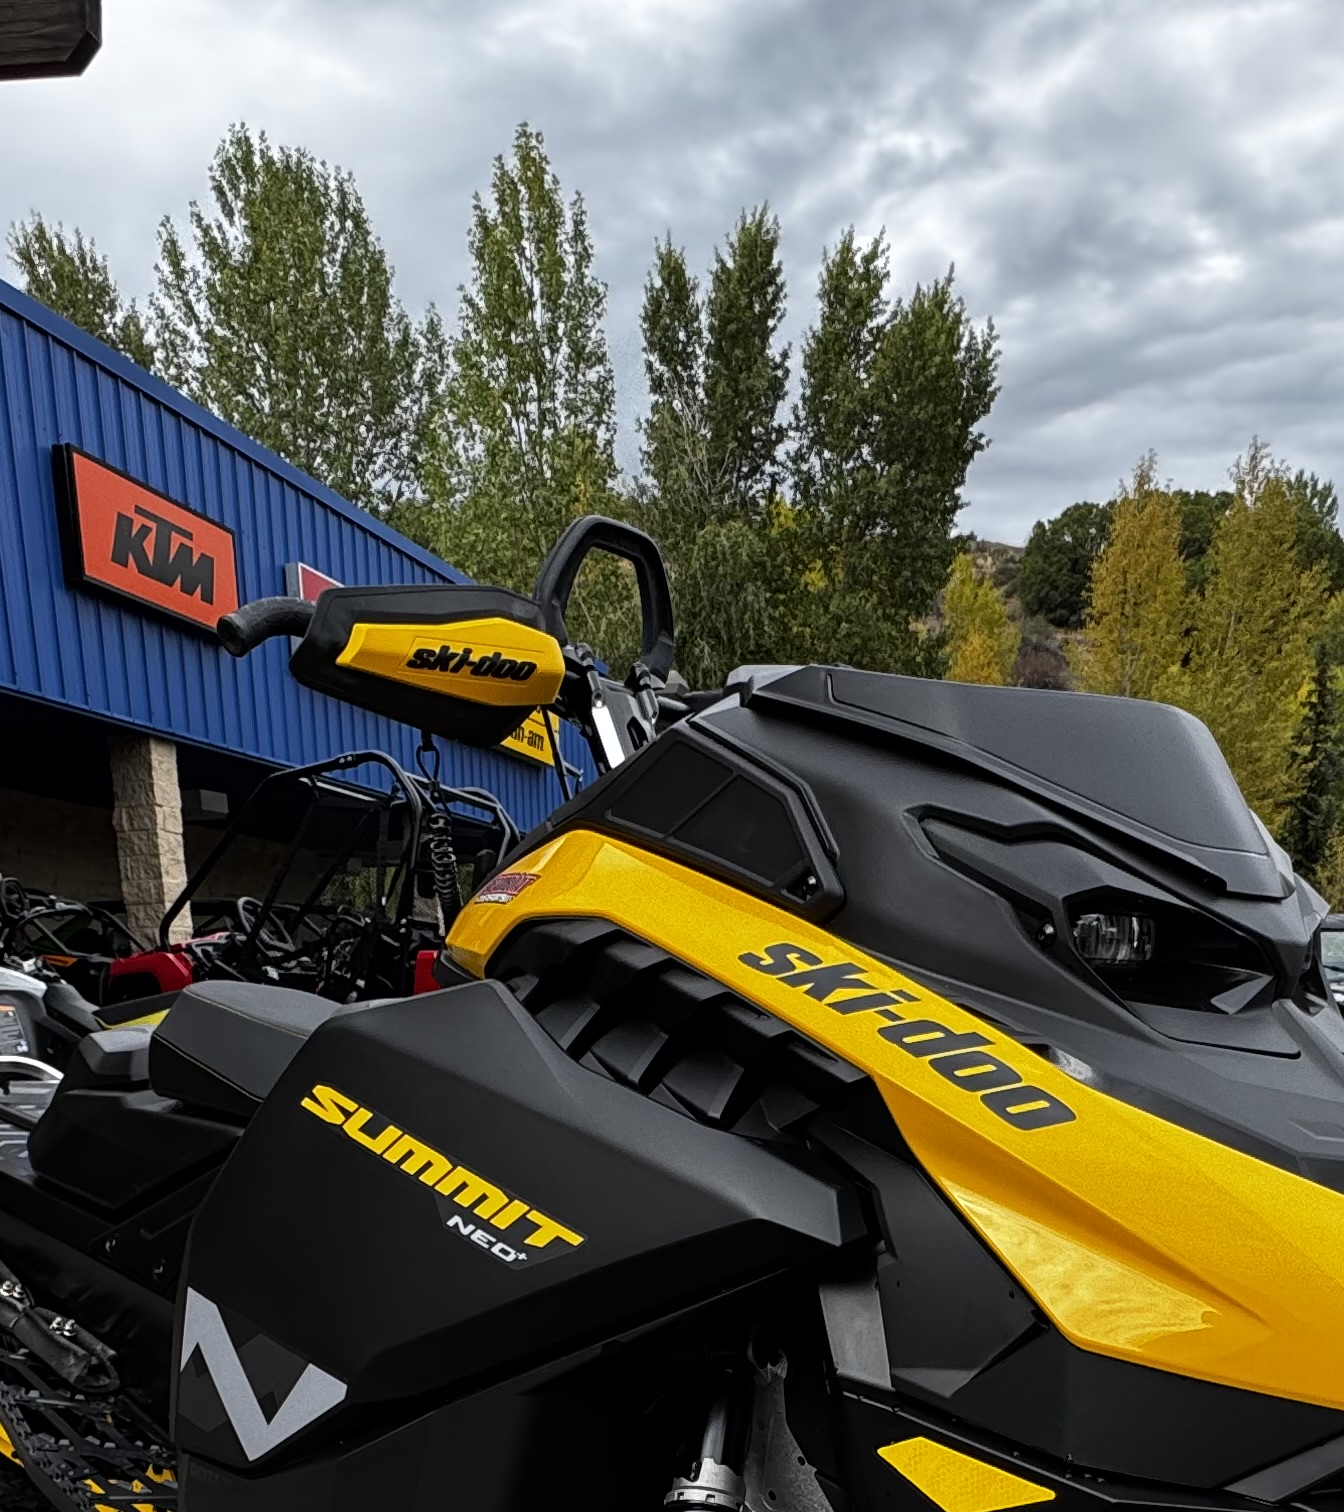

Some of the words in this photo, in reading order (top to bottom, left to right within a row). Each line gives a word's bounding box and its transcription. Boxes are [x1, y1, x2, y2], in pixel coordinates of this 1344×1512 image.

[111, 504, 214, 606] KTM
[406, 644, 538, 681] ski-doo
[737, 942, 1078, 1132] ski-doo
[300, 1084, 586, 1249] SUMMIT
